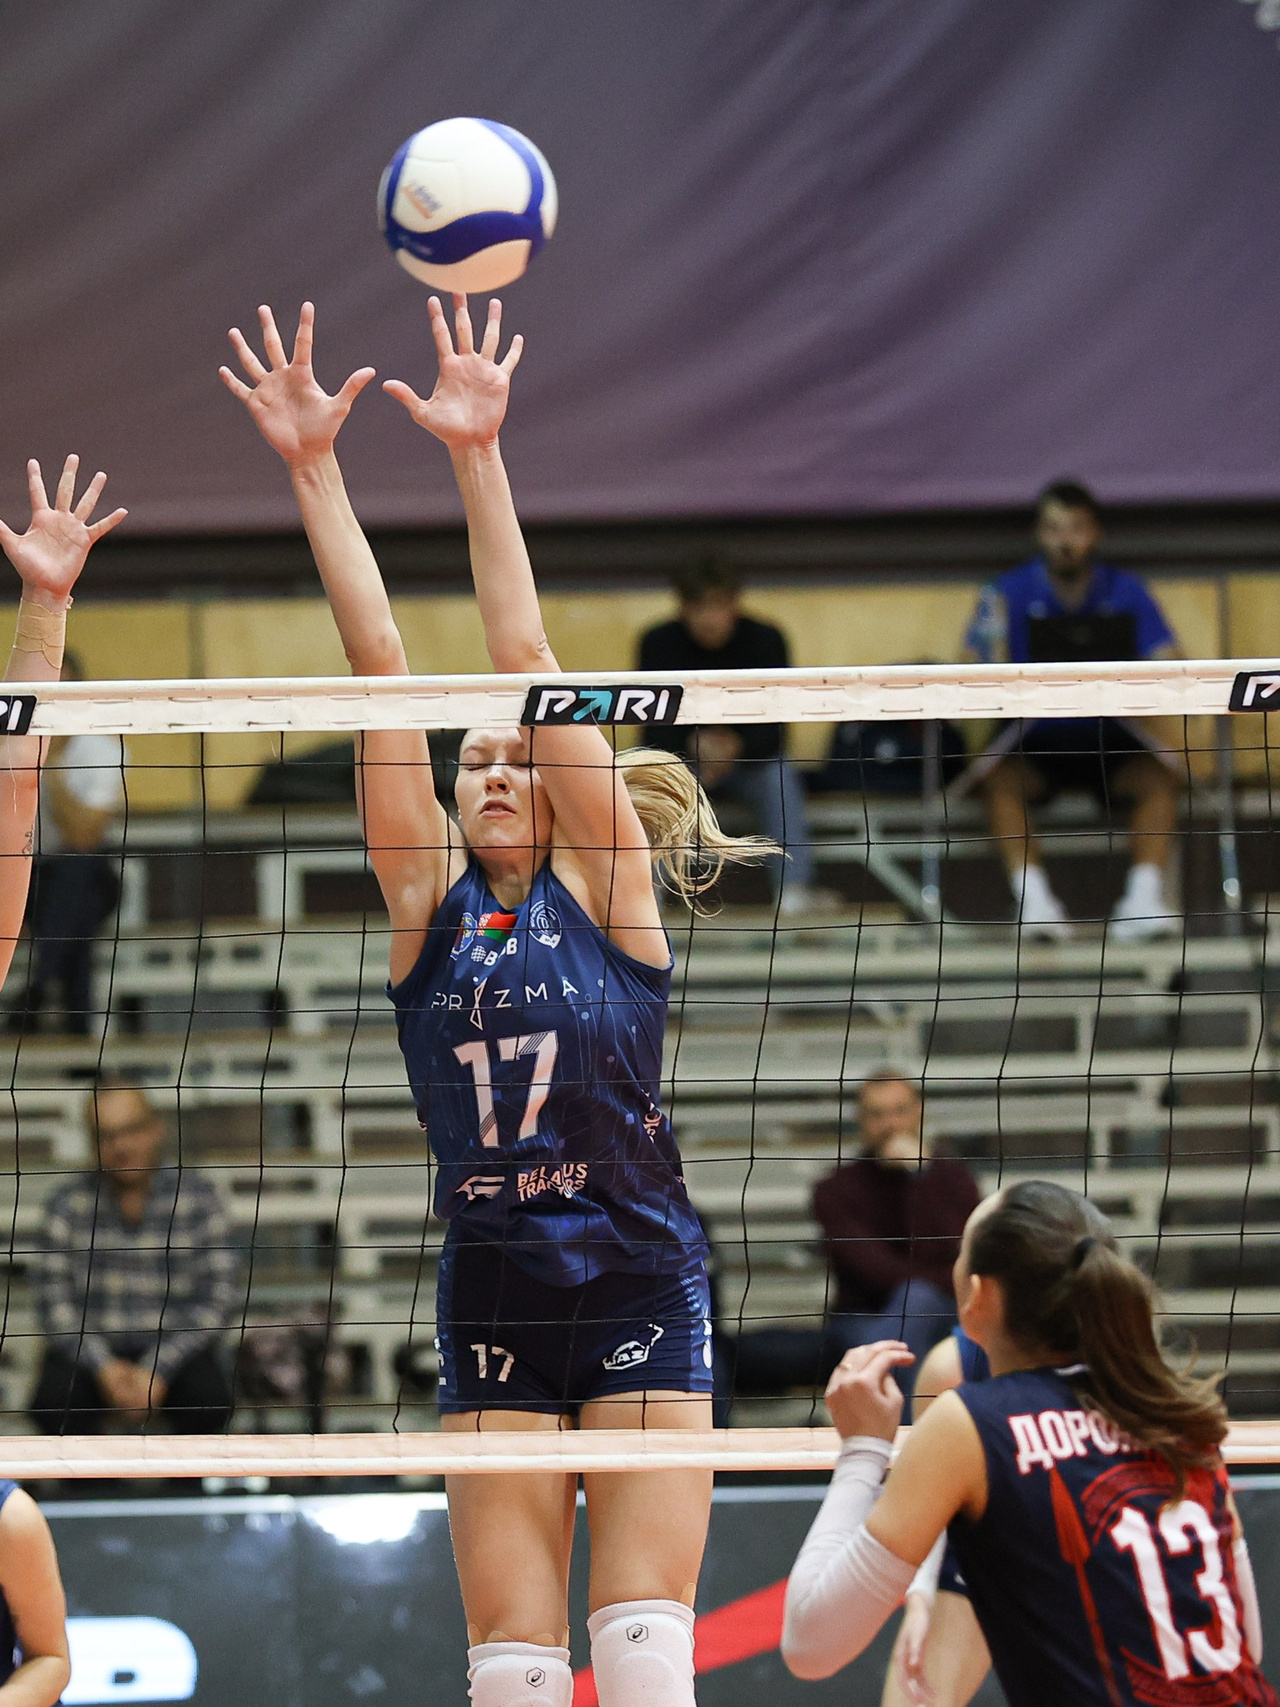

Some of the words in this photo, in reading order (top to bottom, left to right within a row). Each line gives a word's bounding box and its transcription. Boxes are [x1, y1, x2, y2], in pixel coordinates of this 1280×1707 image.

[534, 689, 670, 721] PARI
[452, 1029, 559, 1149] 17
[517, 1163, 588, 1188] BELAUS
[470, 1343, 515, 1383] 17
[1007, 1409, 1131, 1474] ДОРО
[1108, 1499, 1243, 1681] 13
